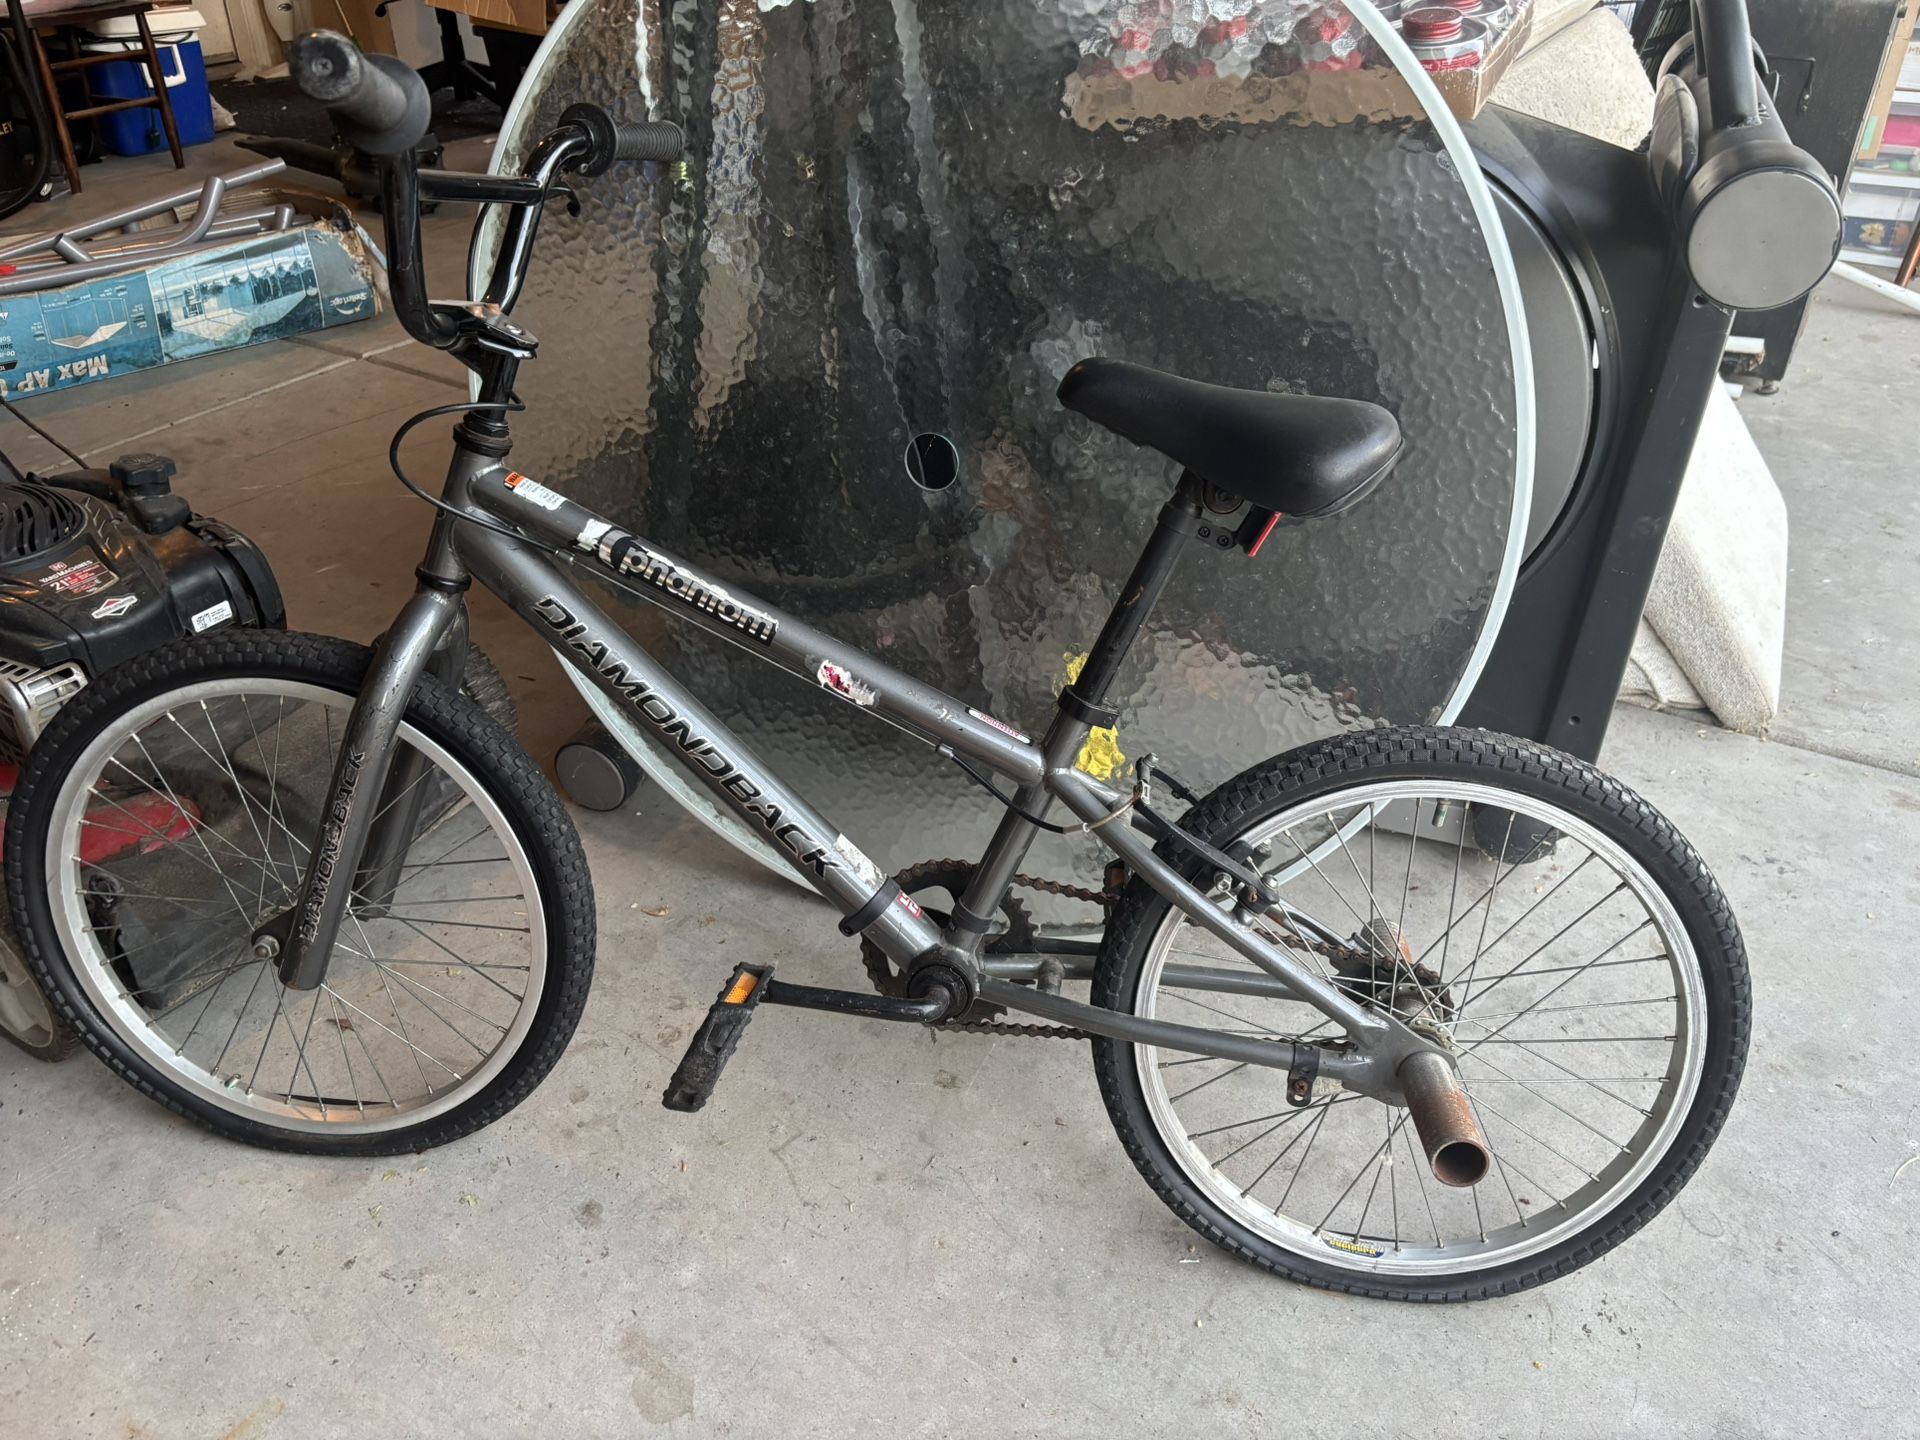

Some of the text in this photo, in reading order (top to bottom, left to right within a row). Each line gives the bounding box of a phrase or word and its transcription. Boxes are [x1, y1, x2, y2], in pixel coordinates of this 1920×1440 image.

[17, 368, 50, 393] AP
[57, 354, 109, 381] Max
[532, 593, 848, 879] DIAMONDBACK
